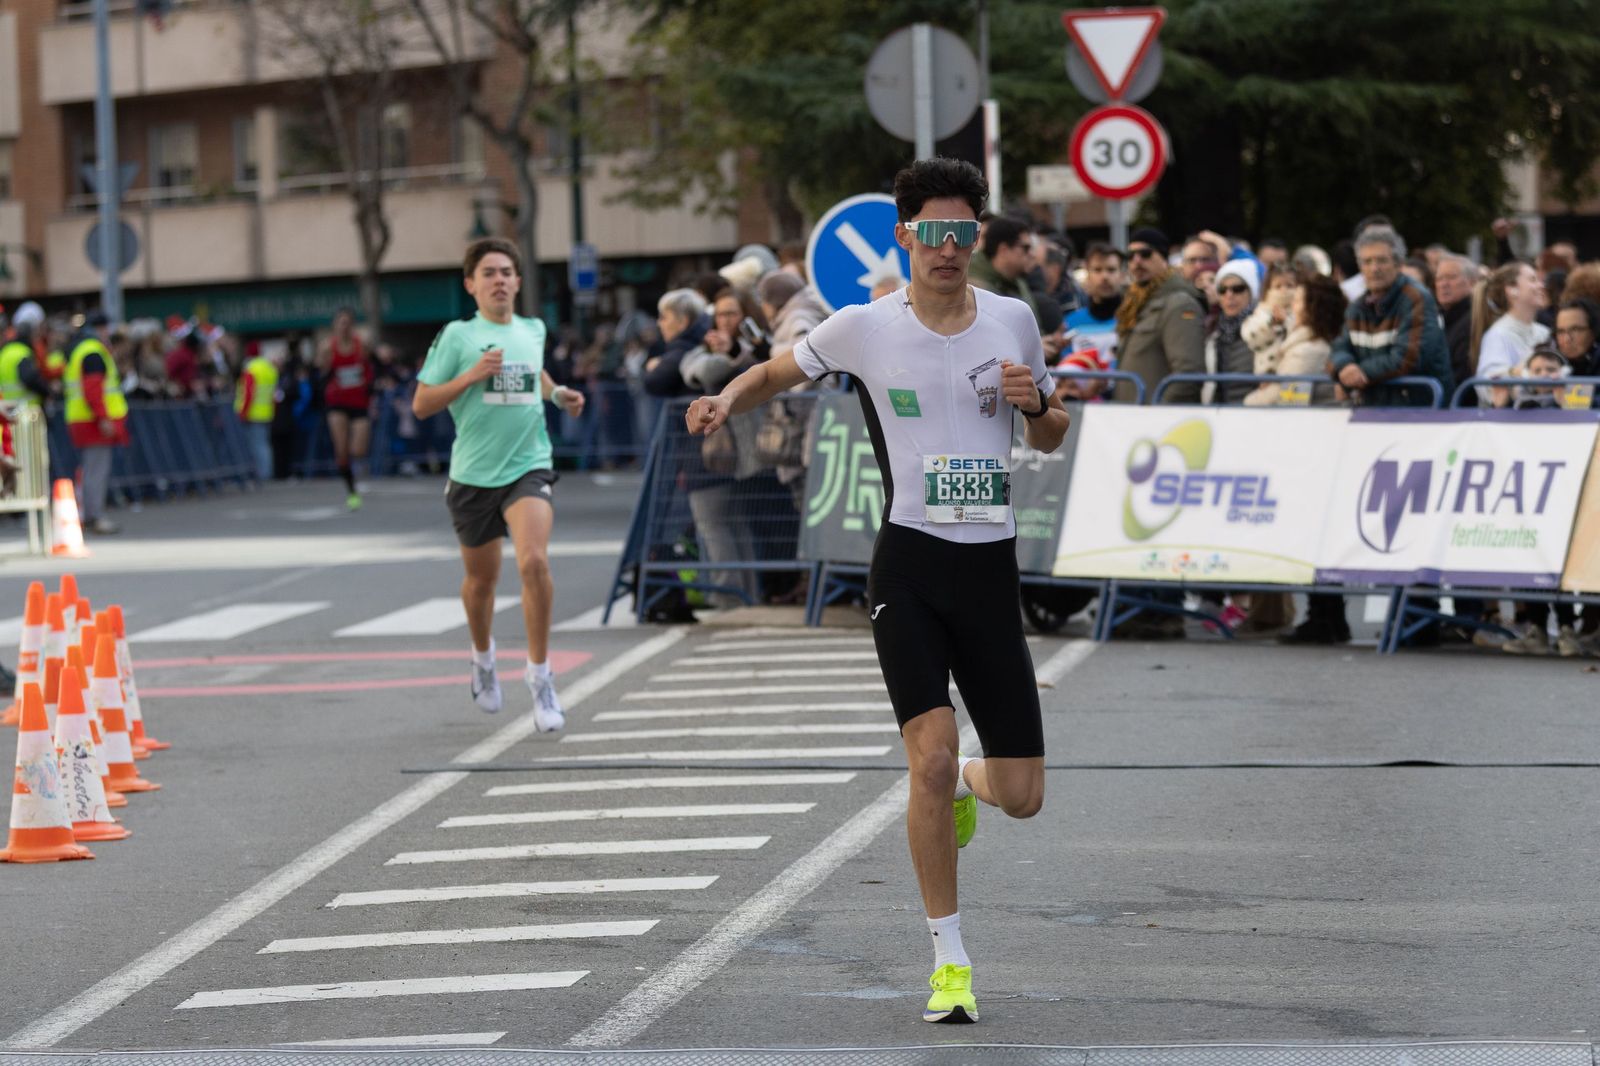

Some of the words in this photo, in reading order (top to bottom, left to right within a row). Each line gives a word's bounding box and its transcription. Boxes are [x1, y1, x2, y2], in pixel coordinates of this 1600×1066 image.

[1092, 139, 1142, 168] 30
[493, 373, 526, 391] 6165
[949, 458, 1004, 470] SETEL
[936, 473, 994, 500] 6333
[1151, 473, 1277, 507] SETEL
[1226, 509, 1275, 524] Grupo
[1451, 523, 1539, 549] fertilizantes
